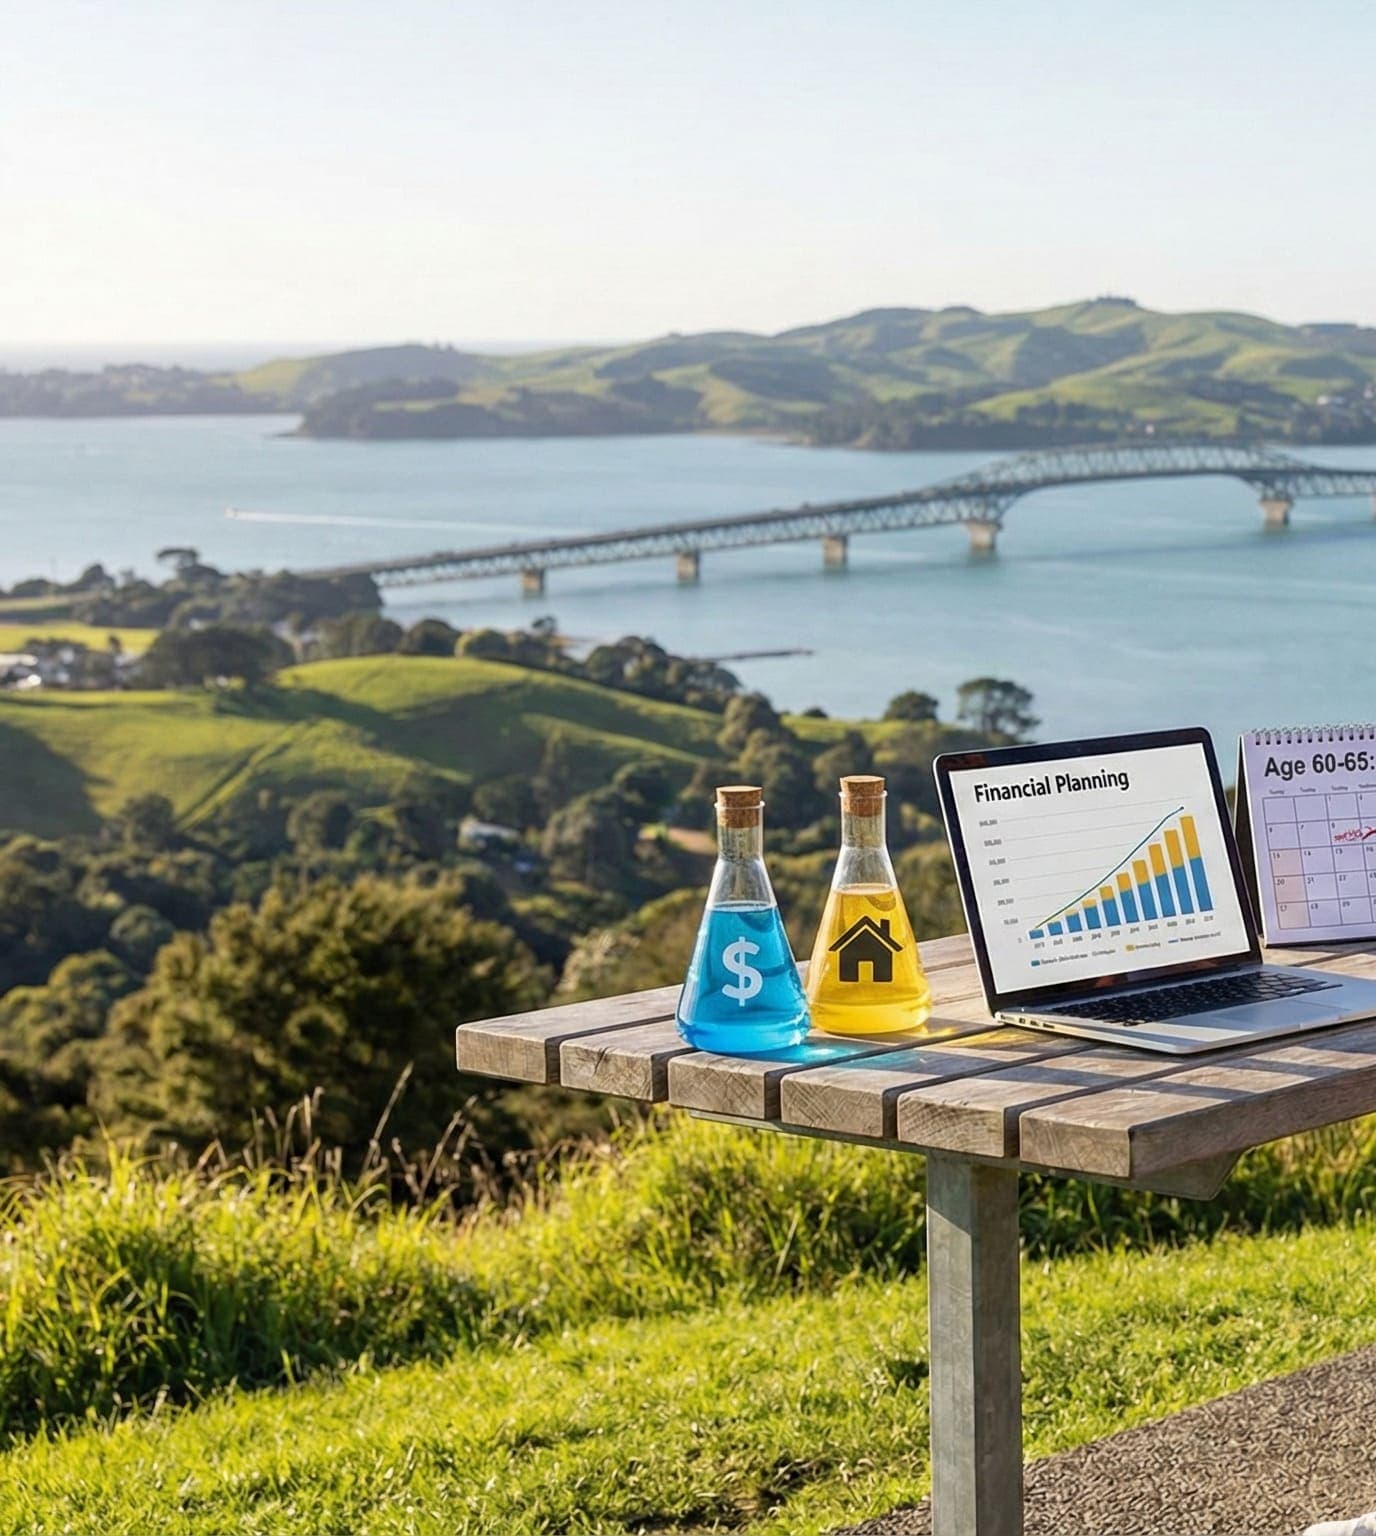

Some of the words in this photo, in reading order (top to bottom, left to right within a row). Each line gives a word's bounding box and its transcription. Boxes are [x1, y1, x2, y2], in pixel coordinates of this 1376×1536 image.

[1264, 757, 1306, 781] Age
[1312, 751, 1375, 773] 60-65:
[974, 776, 1052, 803] Financial
[1055, 769, 1130, 793] Planning
[722, 937, 763, 1007] $
